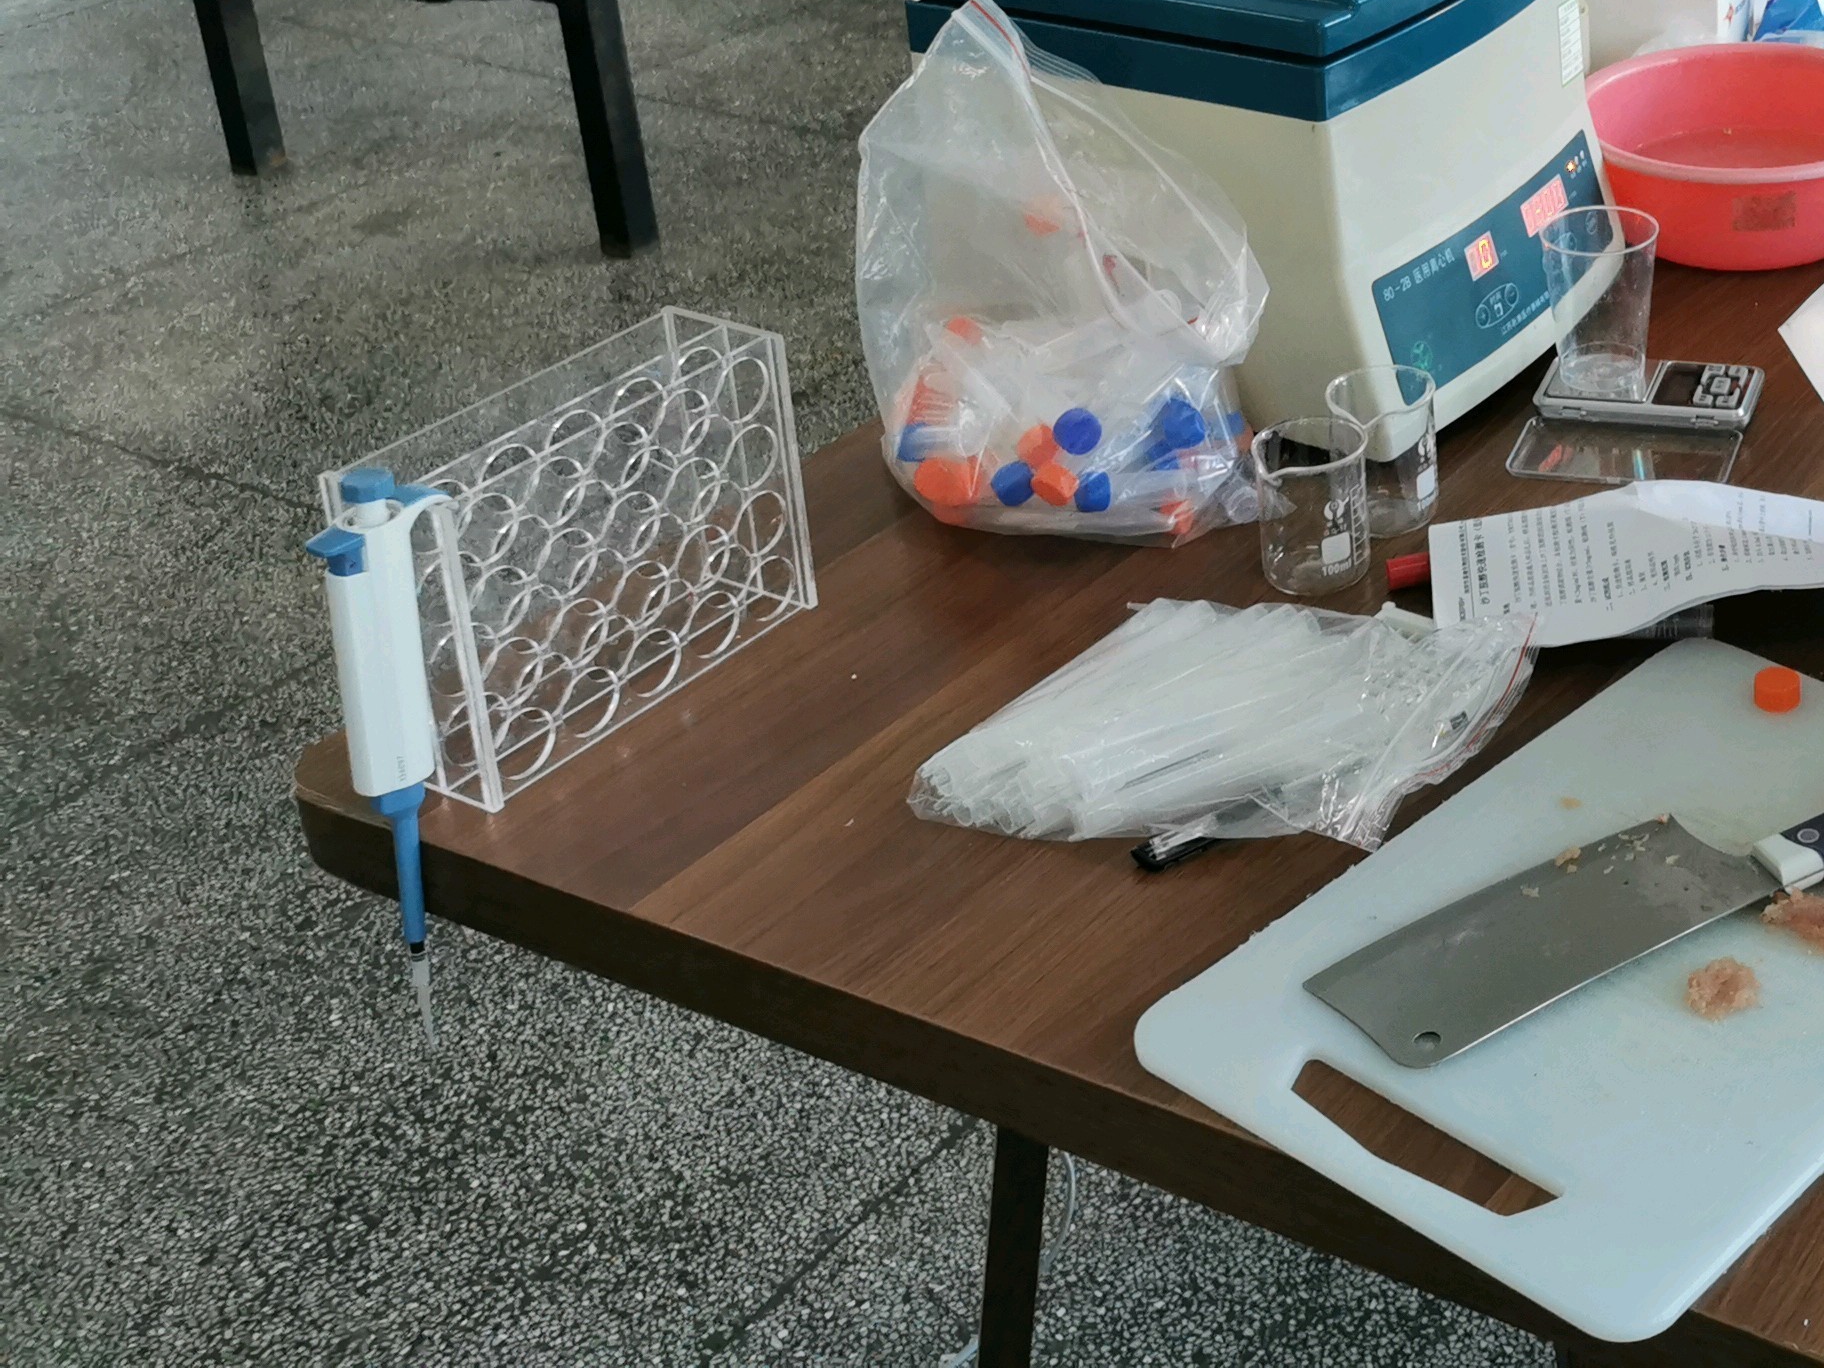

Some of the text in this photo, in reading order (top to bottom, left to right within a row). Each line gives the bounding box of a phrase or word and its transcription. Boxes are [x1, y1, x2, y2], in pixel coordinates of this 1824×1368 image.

[1412, 247, 1456, 285] 医用离心机
[1321, 557, 1352, 577] 100ml
